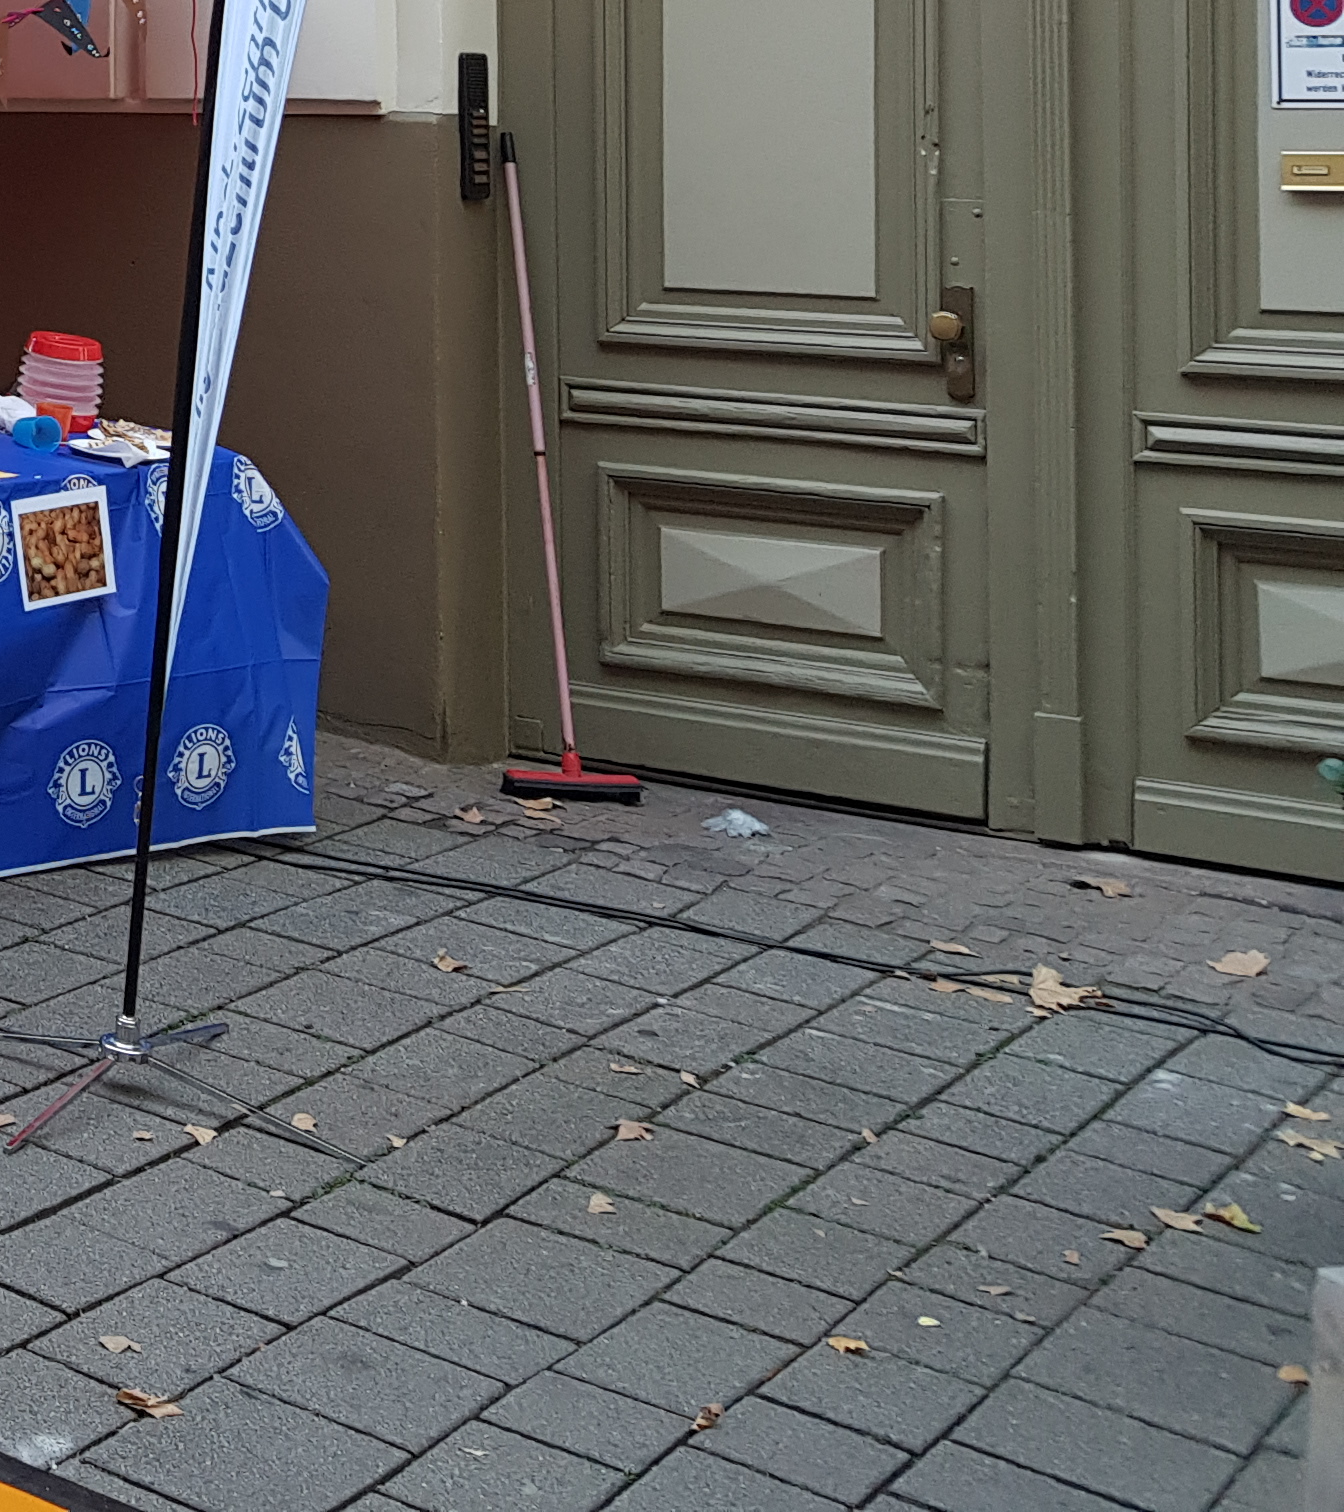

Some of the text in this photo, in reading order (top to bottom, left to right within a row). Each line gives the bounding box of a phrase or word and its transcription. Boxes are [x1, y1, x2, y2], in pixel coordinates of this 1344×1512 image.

[67, 479, 94, 491] ION
[247, 476, 265, 504] L
[185, 727, 226, 748] LIONS
[65, 744, 108, 765] LIONS
[195, 752, 212, 780] L
[78, 767, 96, 797] L
